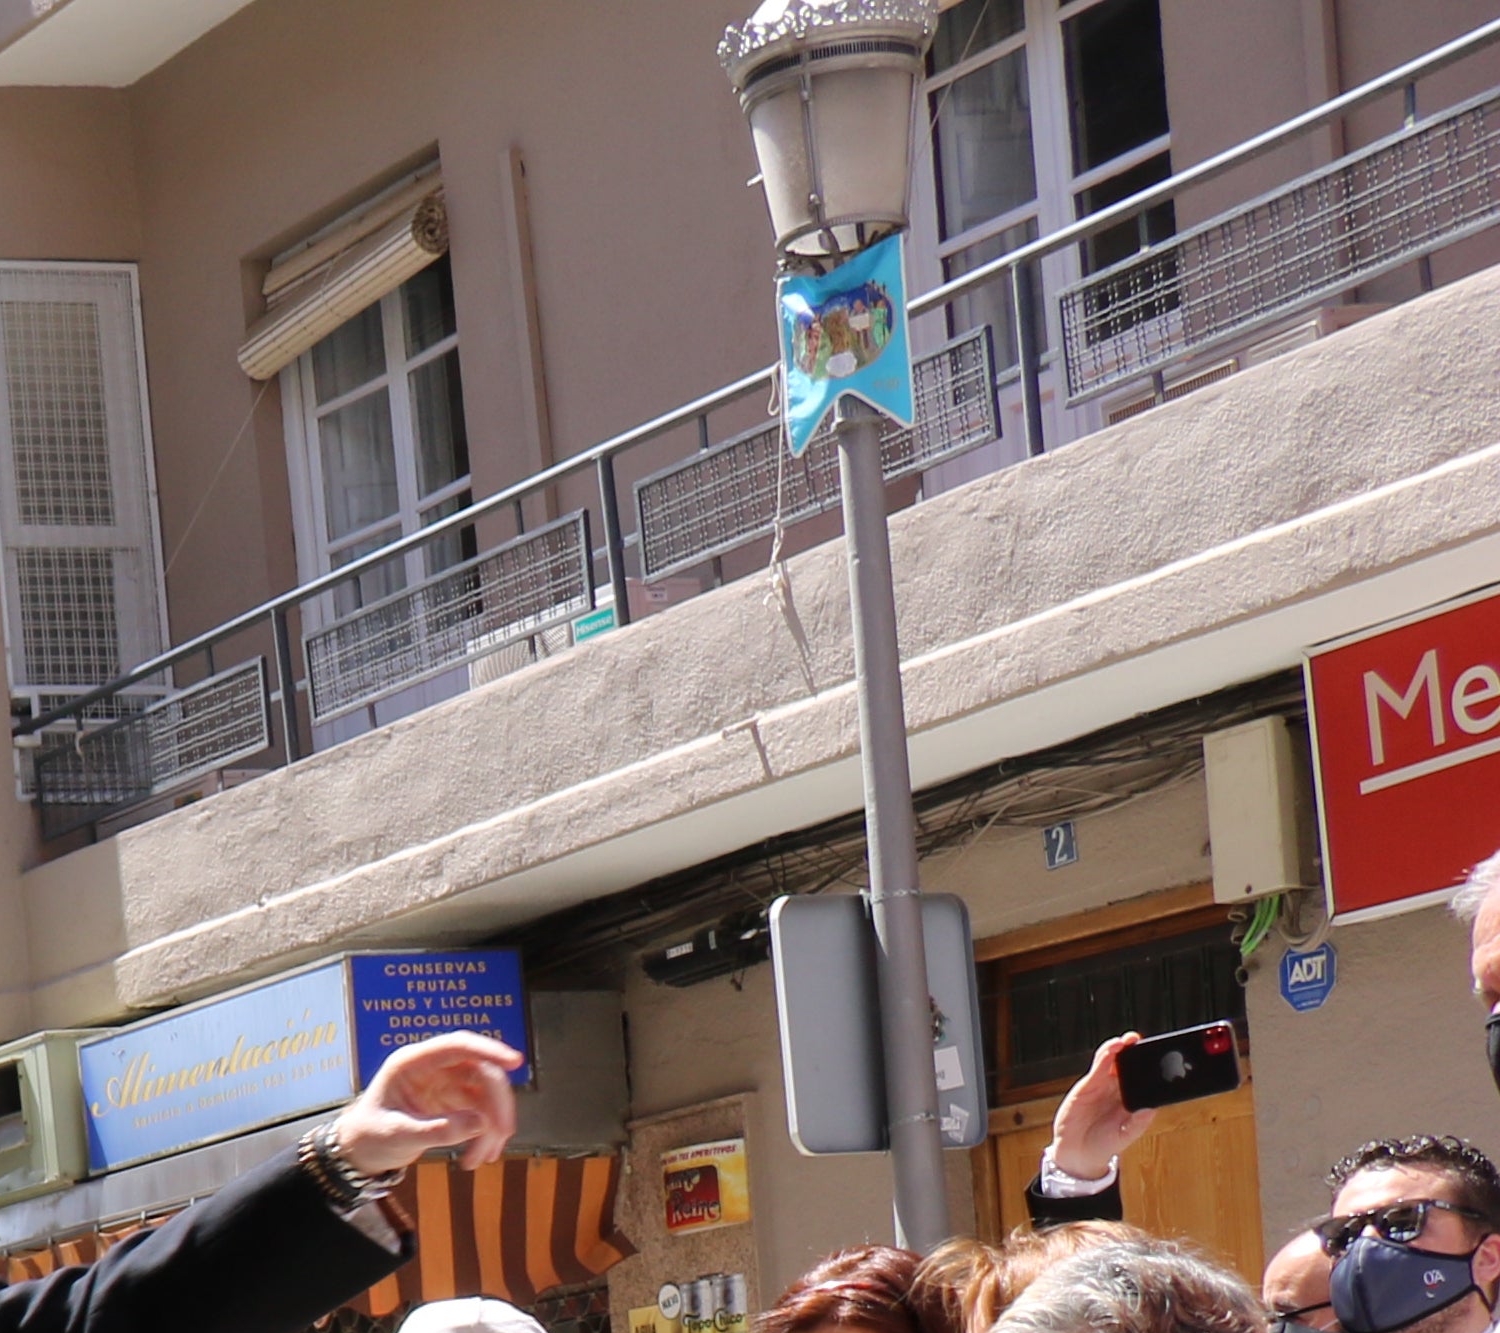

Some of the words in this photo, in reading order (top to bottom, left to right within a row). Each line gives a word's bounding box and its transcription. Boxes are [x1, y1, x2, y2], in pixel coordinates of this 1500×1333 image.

[1363, 648, 1500, 767] Me
[1051, 826, 1068, 865] 2
[383, 960, 487, 977] CONSERVAS
[1289, 954, 1327, 986] ADT
[406, 979, 467, 993] FRUTAS
[362, 998, 417, 1011] VINOS
[423, 997, 433, 1009] Y
[441, 994, 513, 1009] LICORES
[389, 1013, 491, 1028] DROGUERIA
[379, 1029, 503, 1046] CONGOS
[90, 1007, 339, 1117] Alimentación
[713, 1308, 745, 1333] Chico
